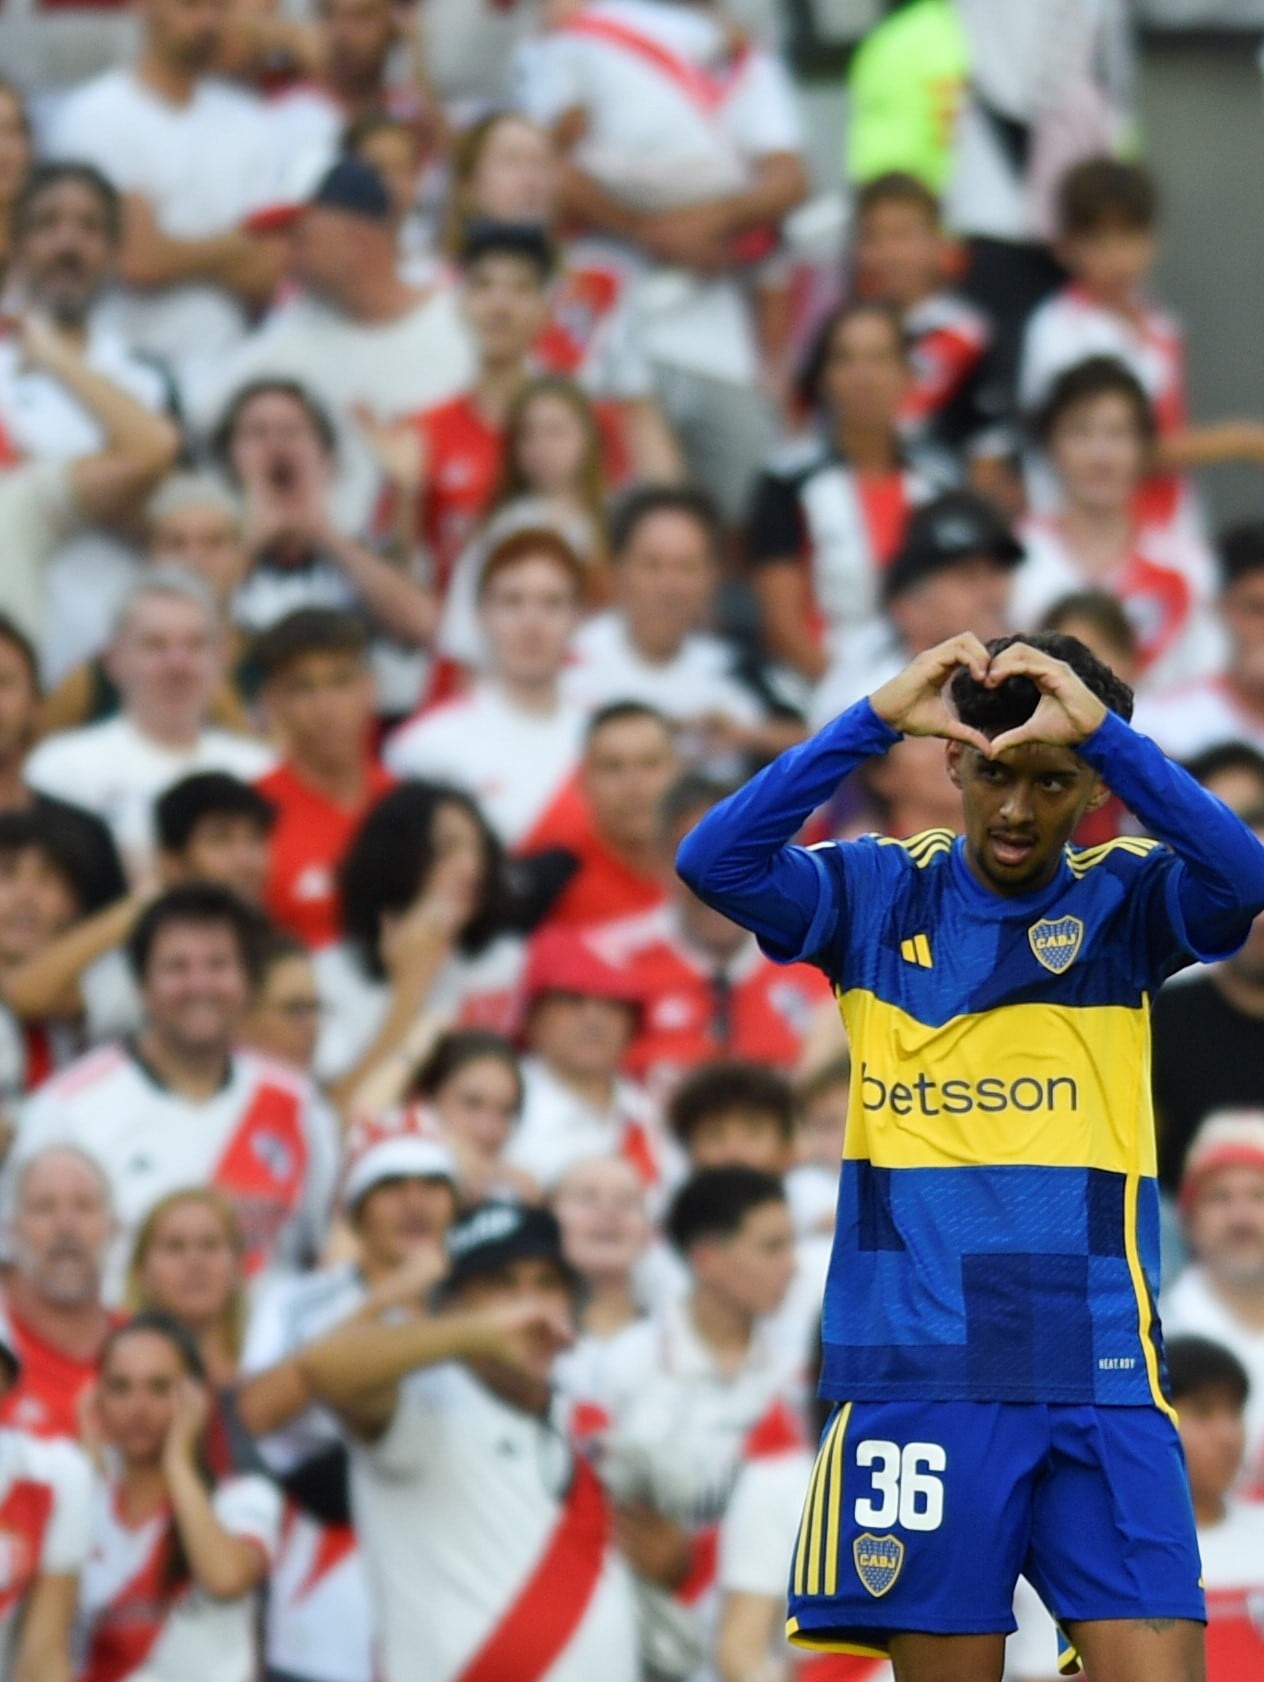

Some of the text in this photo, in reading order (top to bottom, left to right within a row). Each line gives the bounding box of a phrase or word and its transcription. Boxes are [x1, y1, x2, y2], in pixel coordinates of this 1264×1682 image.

[1036, 934, 1076, 949] CABJ
[861, 1061, 1077, 1116] betsson
[854, 1439, 947, 1532] 36
[859, 1553, 896, 1569] CABJ
